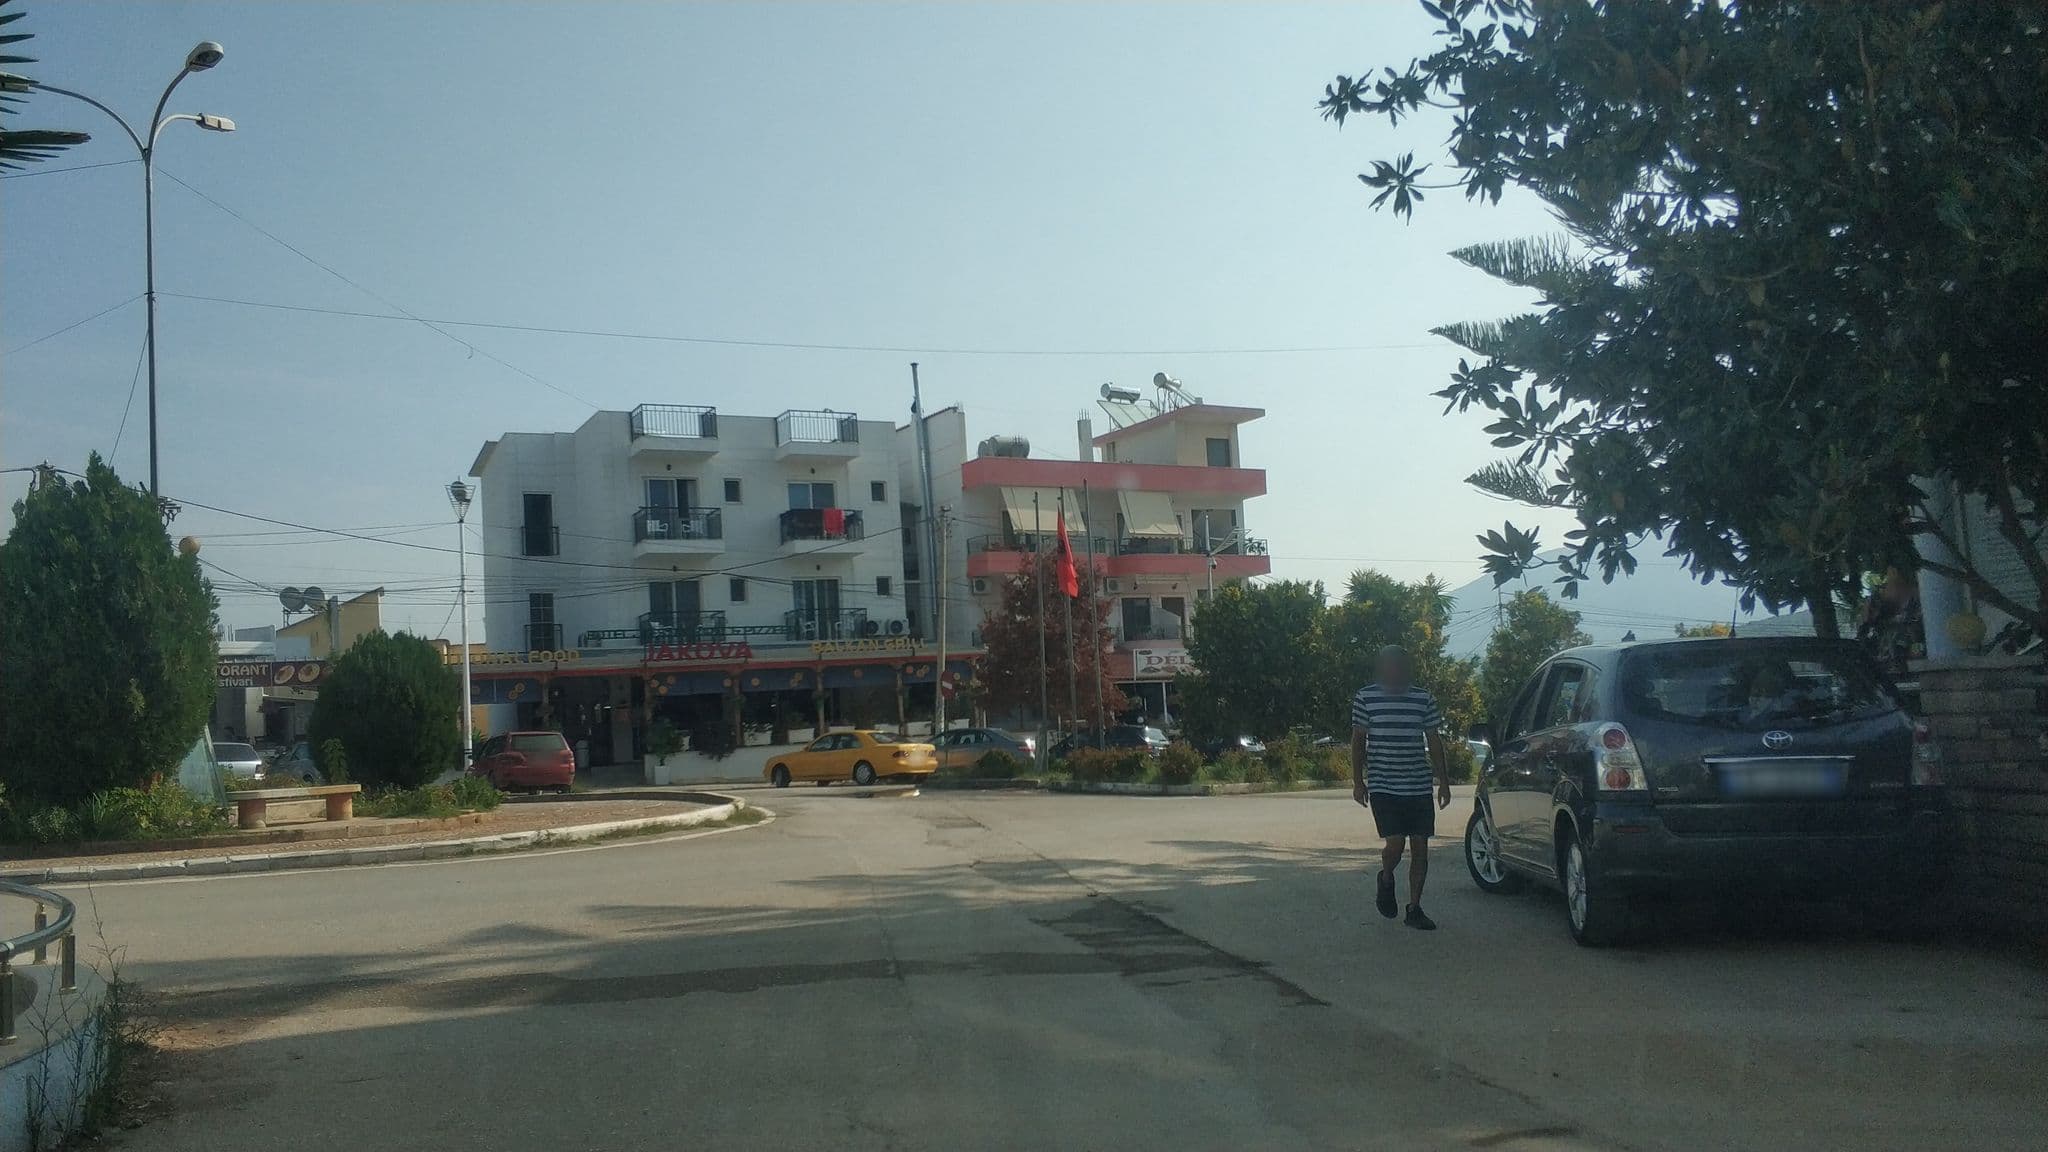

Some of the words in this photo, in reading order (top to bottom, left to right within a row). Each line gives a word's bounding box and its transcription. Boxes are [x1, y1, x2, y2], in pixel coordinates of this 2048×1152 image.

[811, 639, 880, 653] BALKAN
[884, 637, 928, 650] GRILL
[529, 649, 580, 663] FOOD
